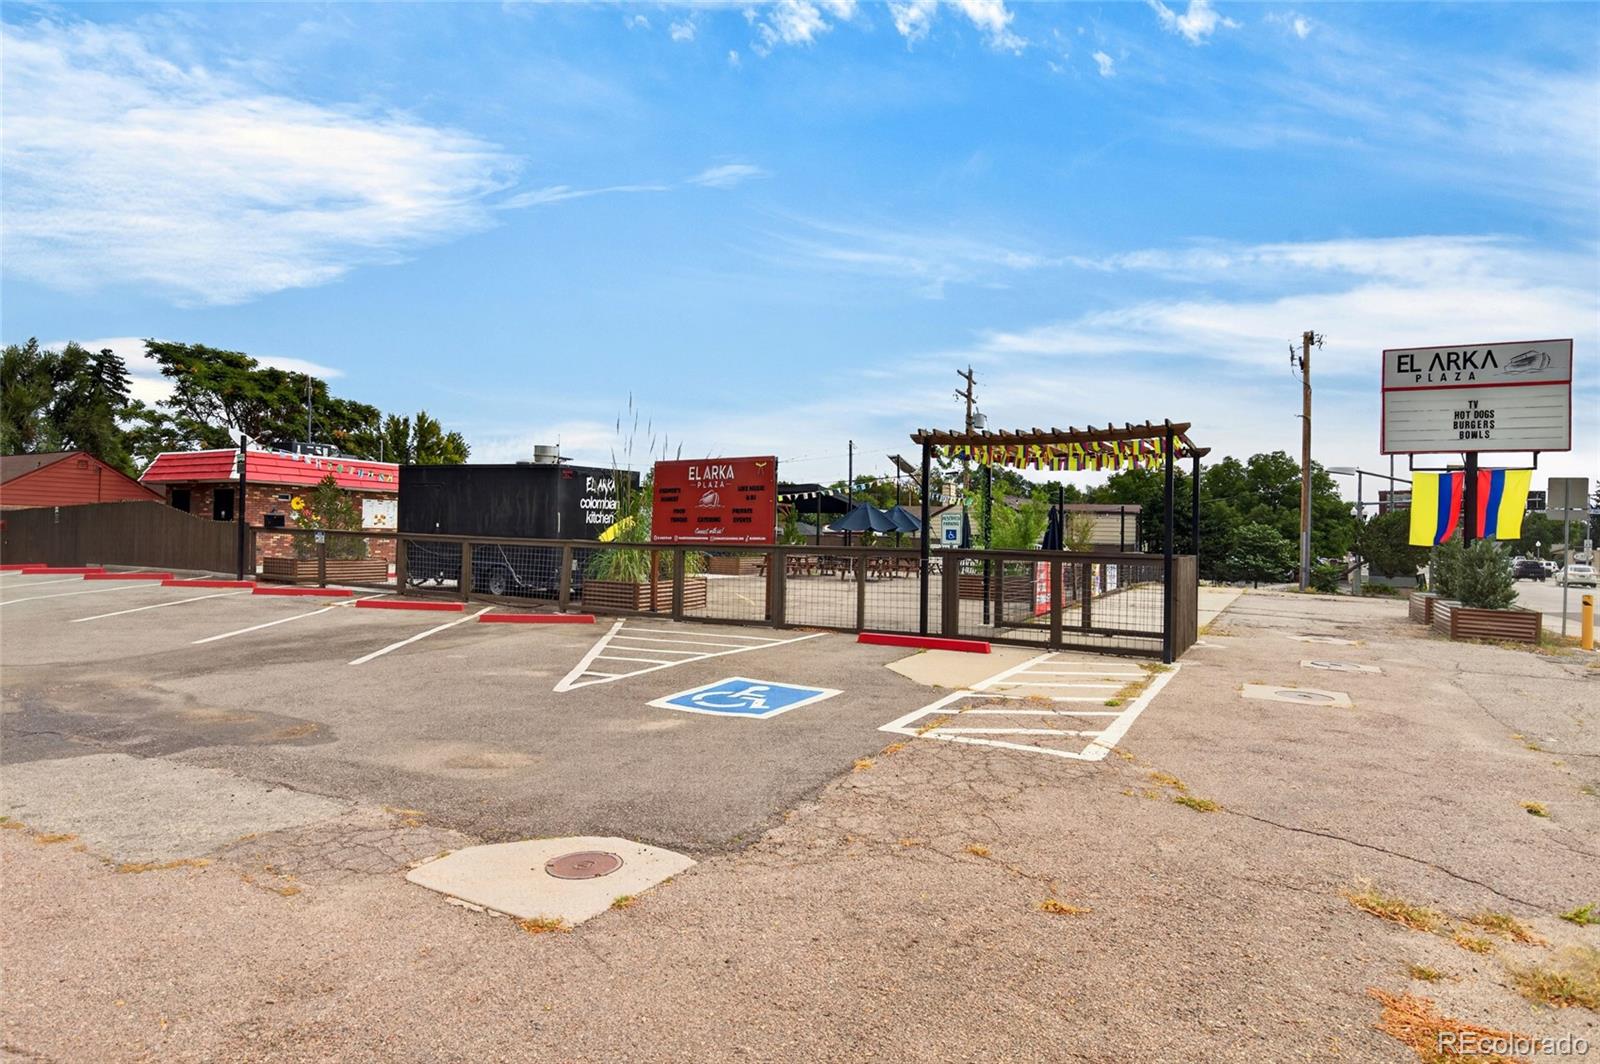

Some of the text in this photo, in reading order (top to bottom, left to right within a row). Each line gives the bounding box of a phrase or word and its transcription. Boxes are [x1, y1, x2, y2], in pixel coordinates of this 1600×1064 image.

[1397, 349, 1498, 373] EL ARKA
[1415, 371, 1475, 383] PLAZA
[1468, 400, 1479, 409] TV
[1454, 409, 1495, 420] HOT DOGS
[1453, 420, 1495, 430] BURGERS
[1459, 430, 1490, 440] BOWLS
[688, 465, 735, 480] EL ARKA
[580, 496, 620, 509] colombian
[585, 511, 614, 524] kitchen
